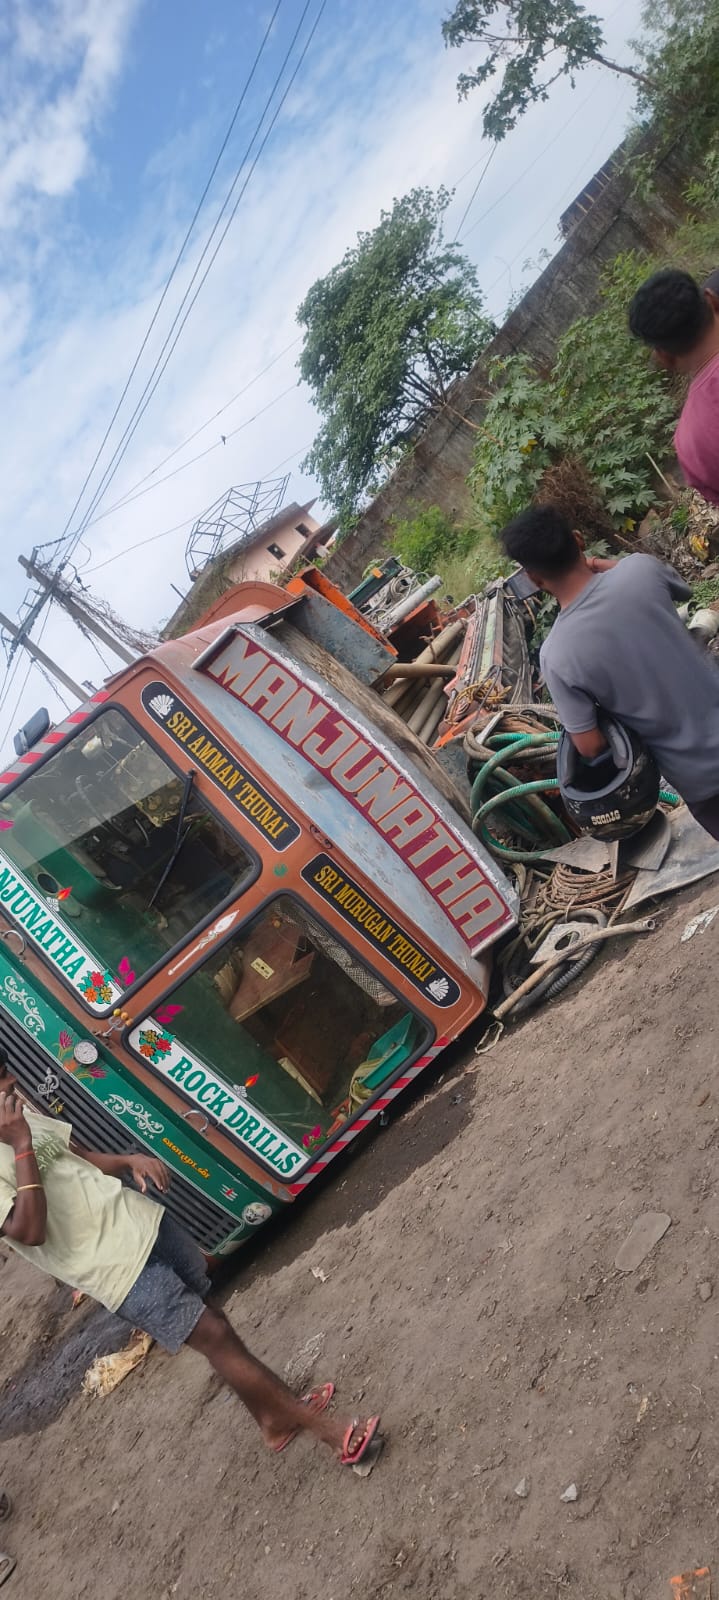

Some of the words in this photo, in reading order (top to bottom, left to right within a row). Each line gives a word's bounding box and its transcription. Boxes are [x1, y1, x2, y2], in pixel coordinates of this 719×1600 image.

[166, 711, 198, 742] SRI
[187, 735, 244, 790] AMMAN
[235, 781, 289, 839] THUNAI
[207, 637, 505, 940] MANJUNATHA
[591, 810, 621, 826] STUDDS
[0, 863, 86, 980] NJUNATHA
[313, 865, 343, 894] SRI
[334, 883, 396, 943] MURUGAN
[387, 934, 436, 982] THUNAI
[168, 1056, 234, 1117] ROCK
[224, 1105, 301, 1174] DRILLS
